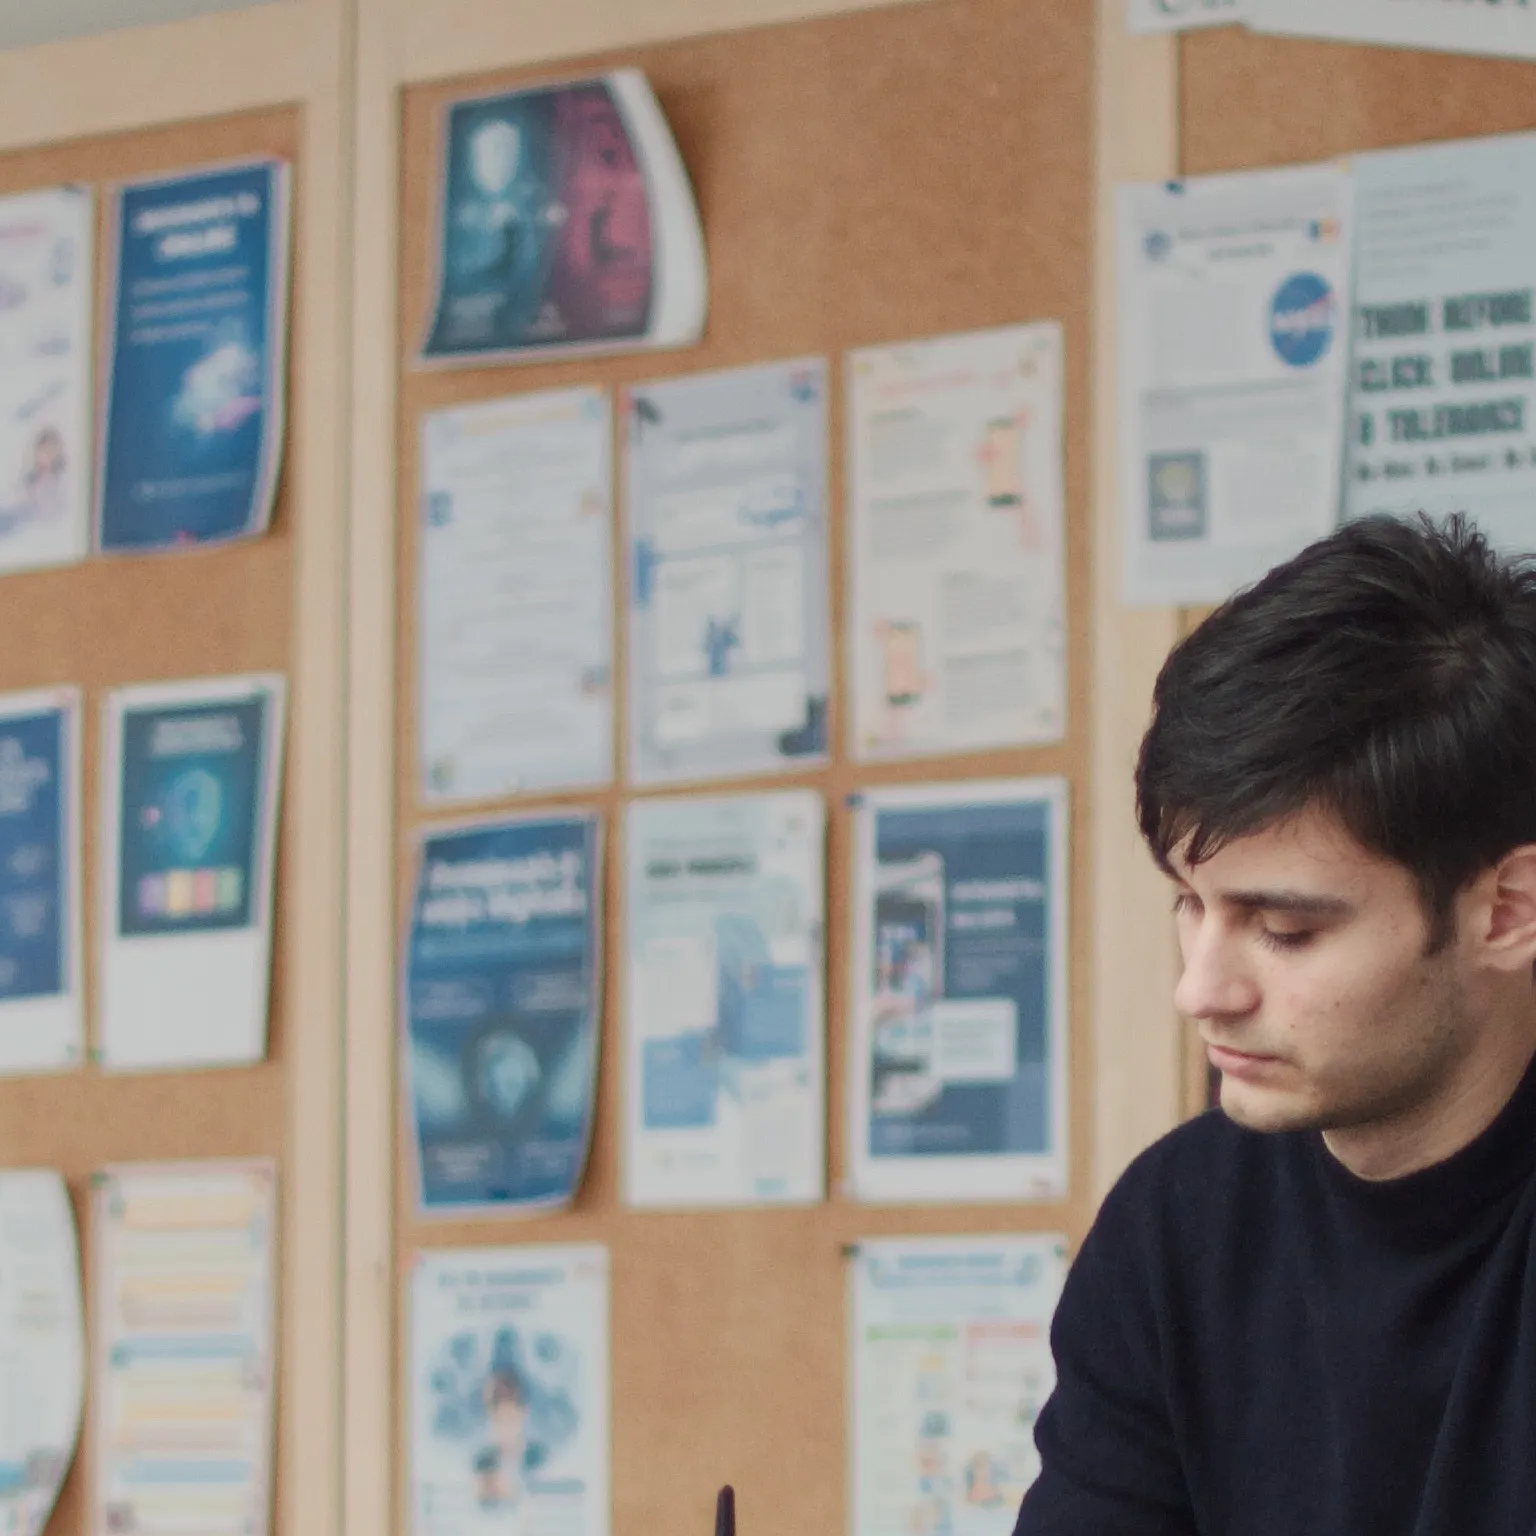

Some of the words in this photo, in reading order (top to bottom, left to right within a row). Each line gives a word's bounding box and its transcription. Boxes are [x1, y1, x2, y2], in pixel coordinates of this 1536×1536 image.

[1360, 302, 1427, 337] THINK
[1443, 288, 1533, 330] BEFORE
[1451, 341, 1533, 382] ONLINE
[1387, 397, 1526, 443] TOLERANCE
